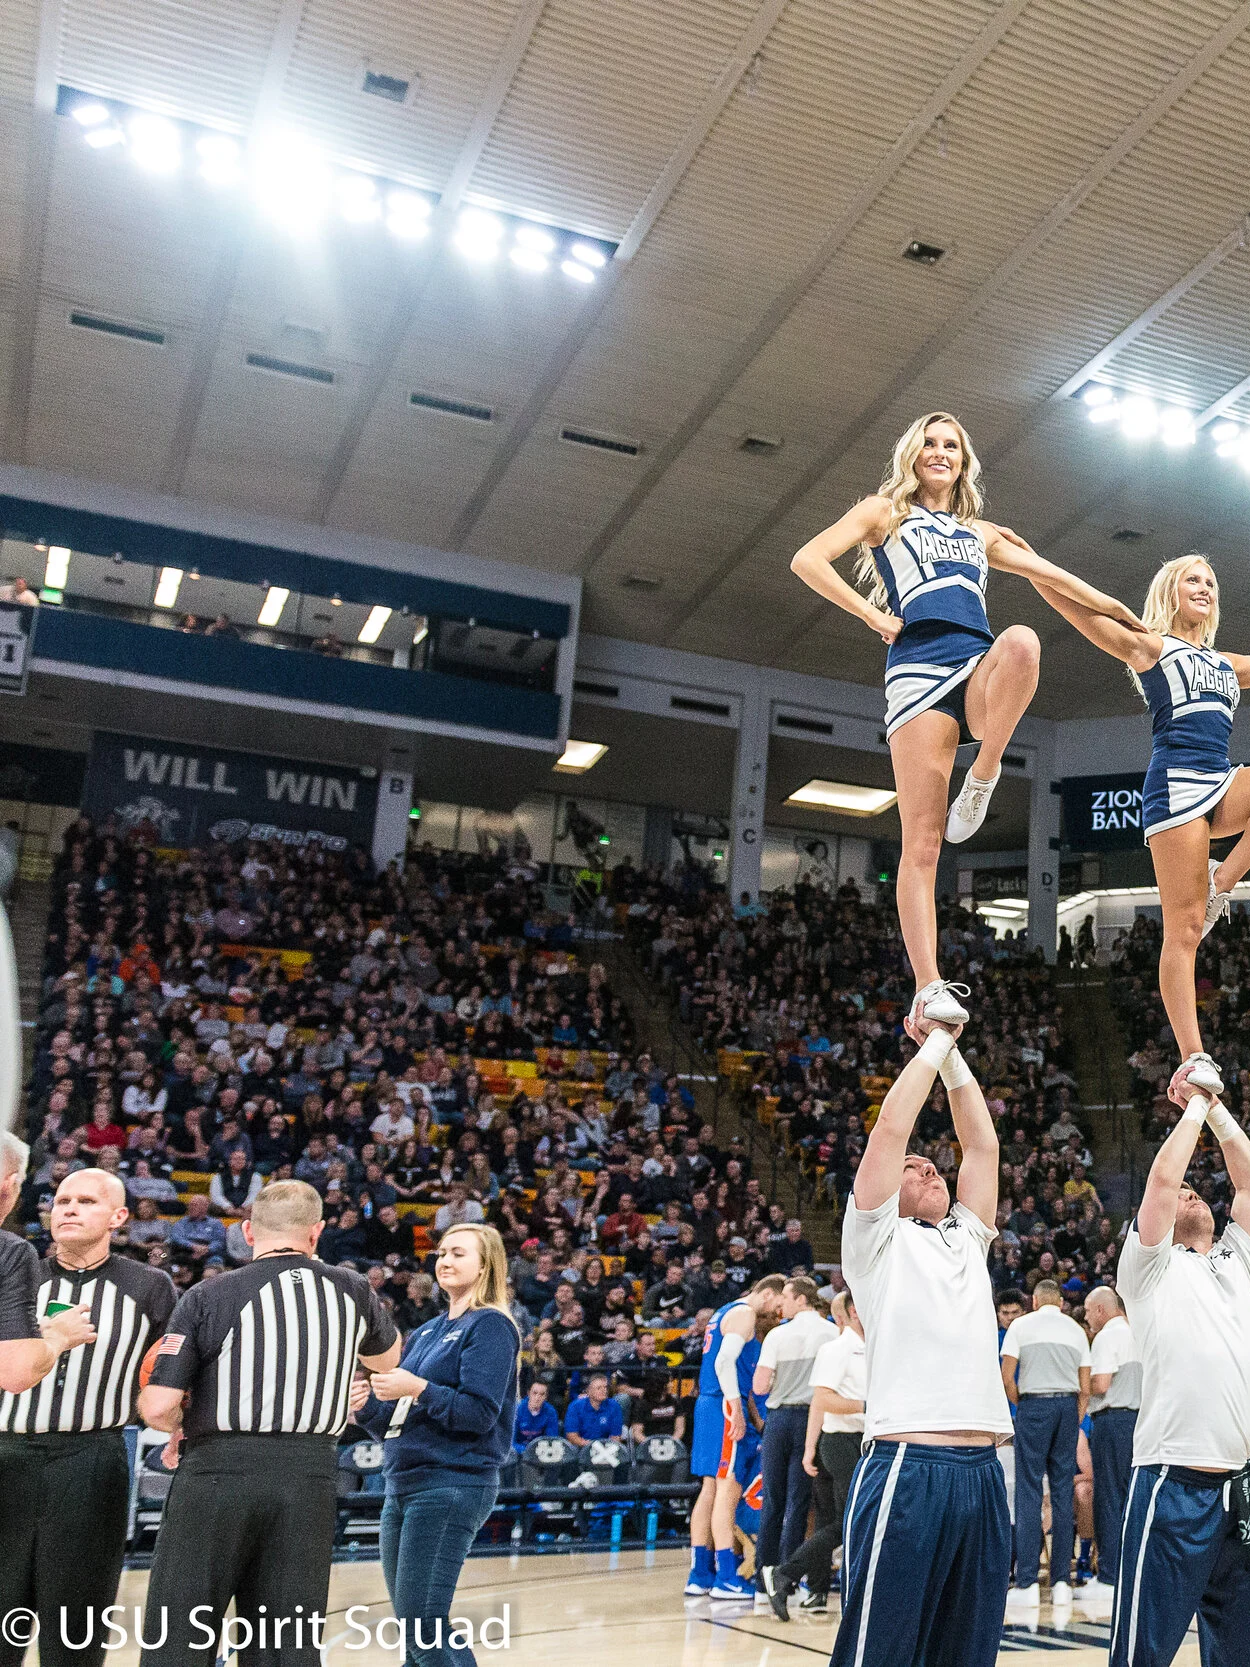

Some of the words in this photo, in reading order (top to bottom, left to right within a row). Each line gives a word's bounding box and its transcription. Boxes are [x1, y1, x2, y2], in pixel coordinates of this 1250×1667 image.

[919, 527, 986, 568] AGGIES
[122, 748, 239, 795] WILL
[265, 768, 358, 810] WIN
[390, 775, 404, 795] B
[1091, 789, 1144, 809] ZION
[1091, 809, 1141, 830] BAN
[742, 828, 757, 844] C
[1041, 871, 1053, 887] D
